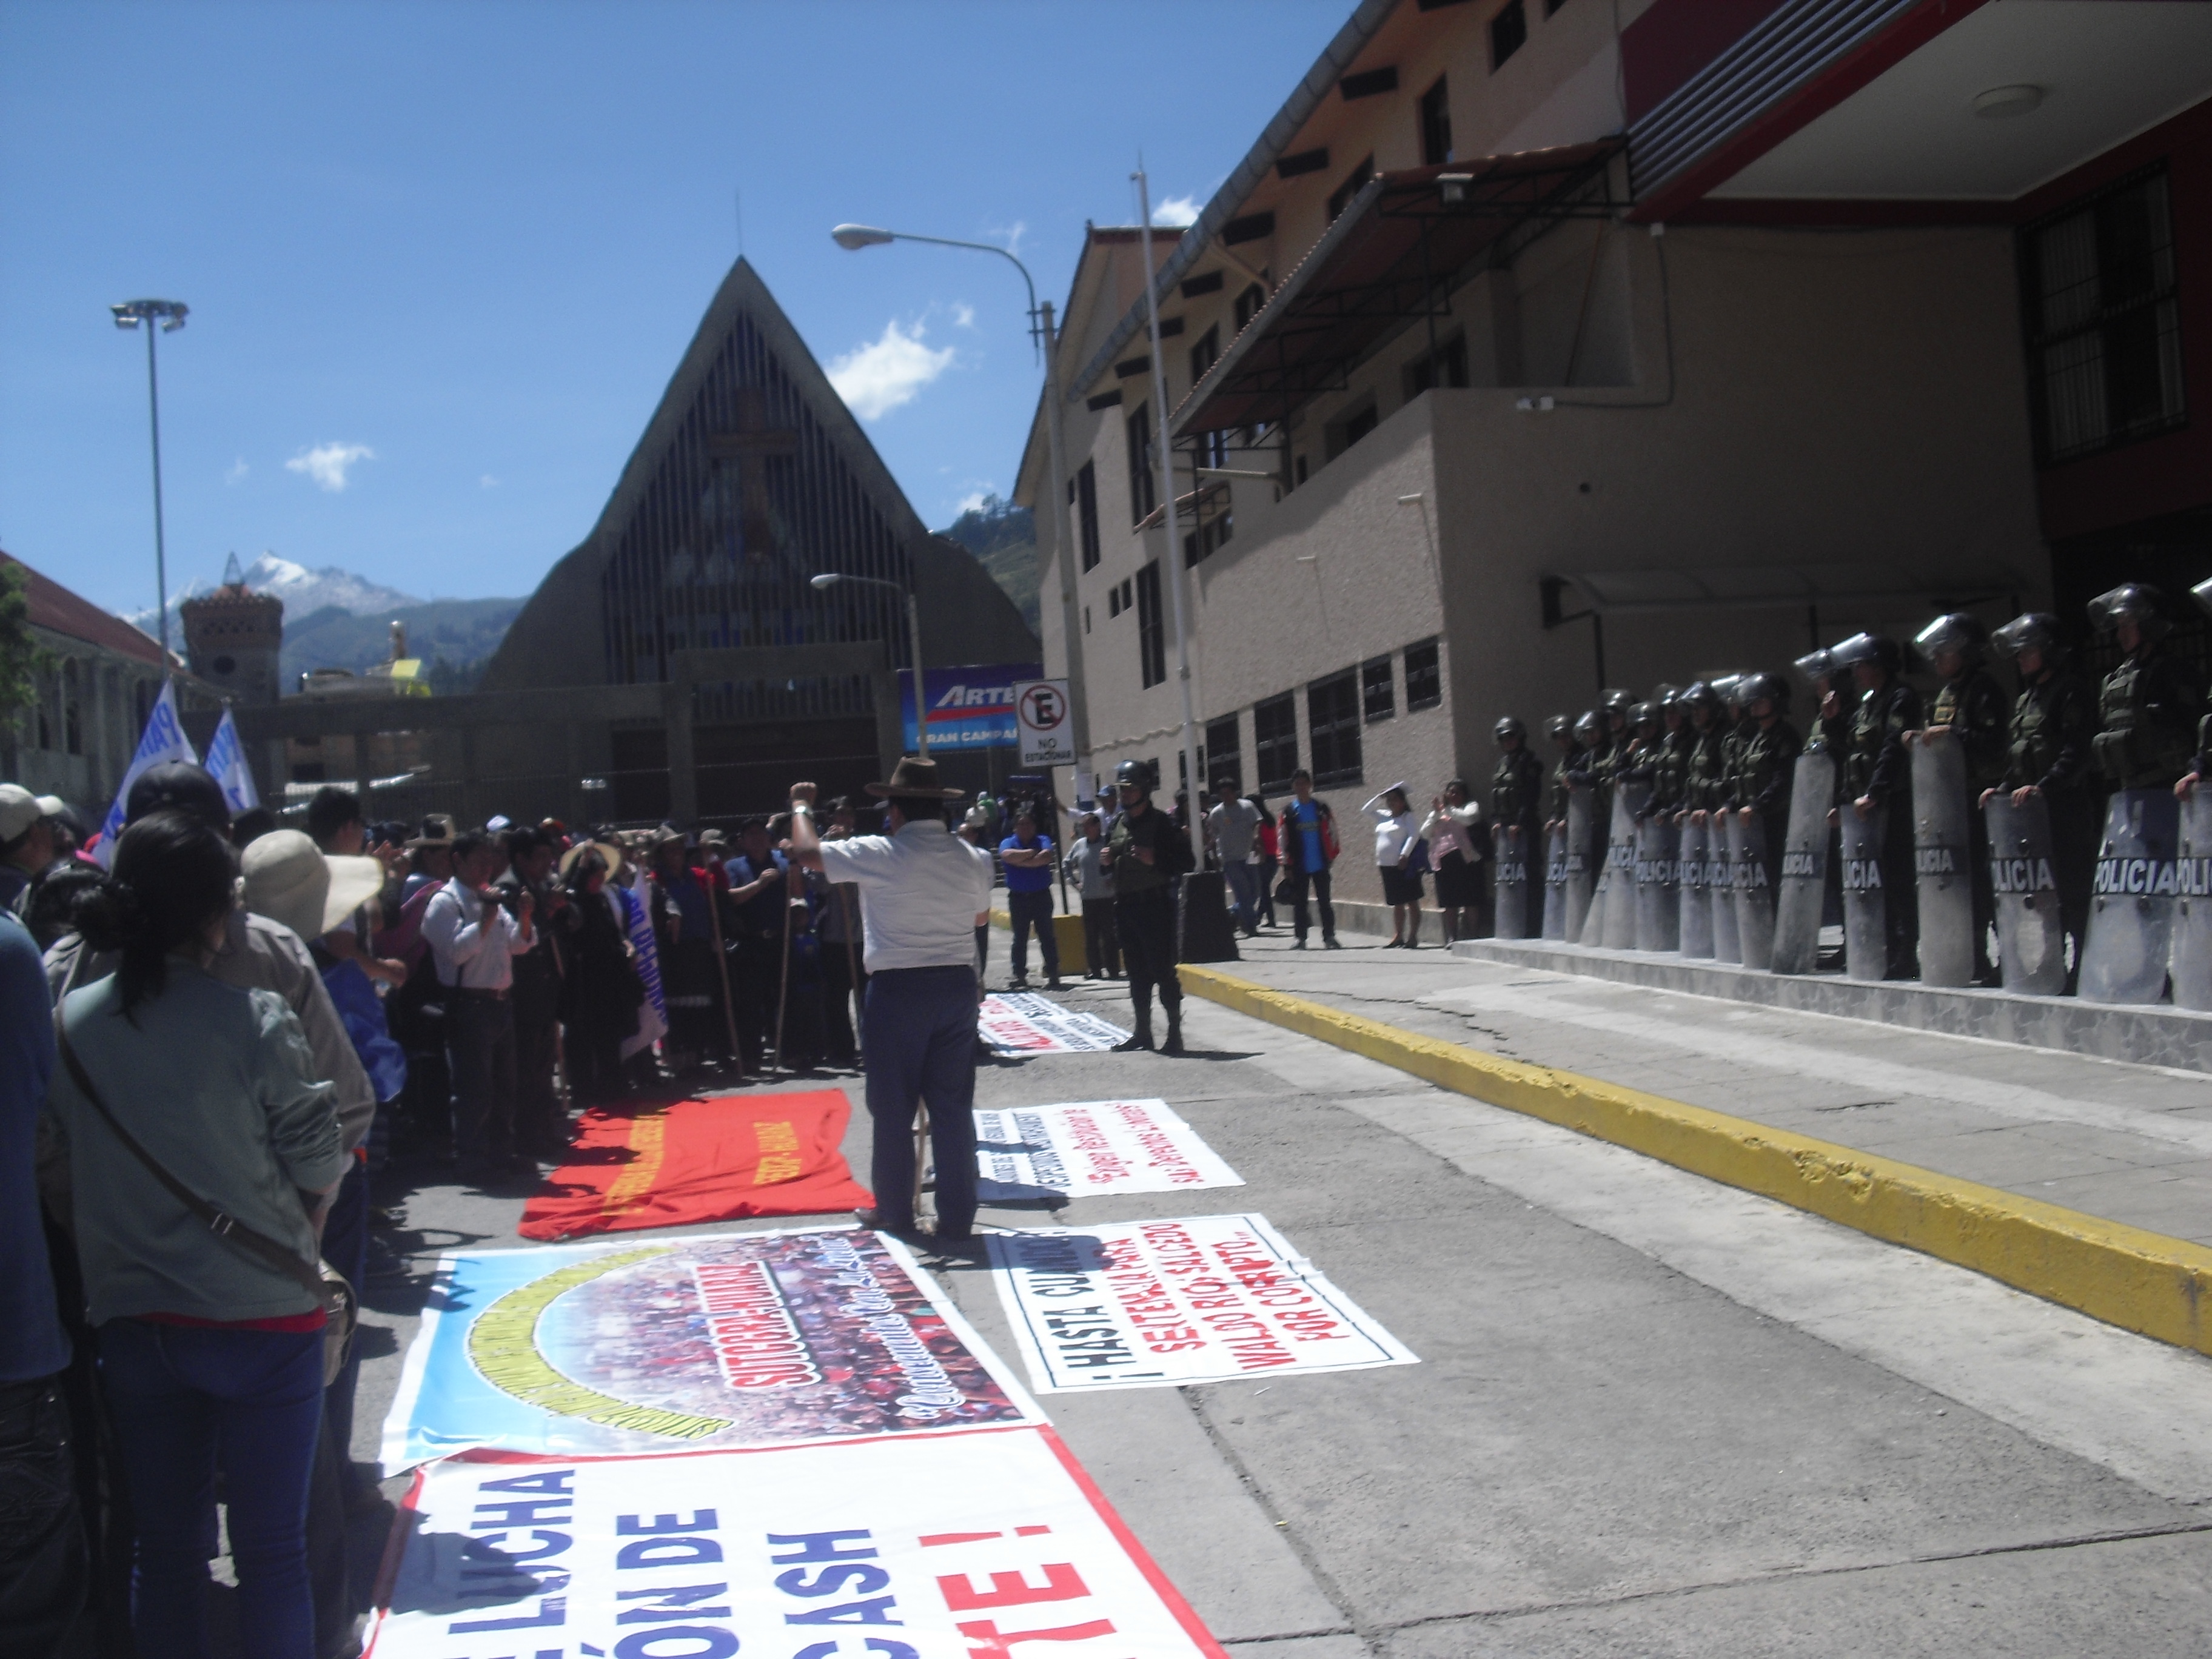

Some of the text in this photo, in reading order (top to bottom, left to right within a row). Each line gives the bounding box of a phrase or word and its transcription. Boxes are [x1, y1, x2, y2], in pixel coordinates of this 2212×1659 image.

[1038, 738, 1057, 749] NO
[2093, 859, 2178, 896] POLICIA
[1095, 1238, 1148, 1272] PARA
[1138, 1224, 1212, 1275] SALCEDO
[840, 1288, 896, 1315] Con
[1199, 1310, 1298, 1370] WALDO
[1270, 1309, 1351, 1342] POR
[449, 1470, 576, 1635] LUCHA
[617, 1509, 723, 1570] DE
